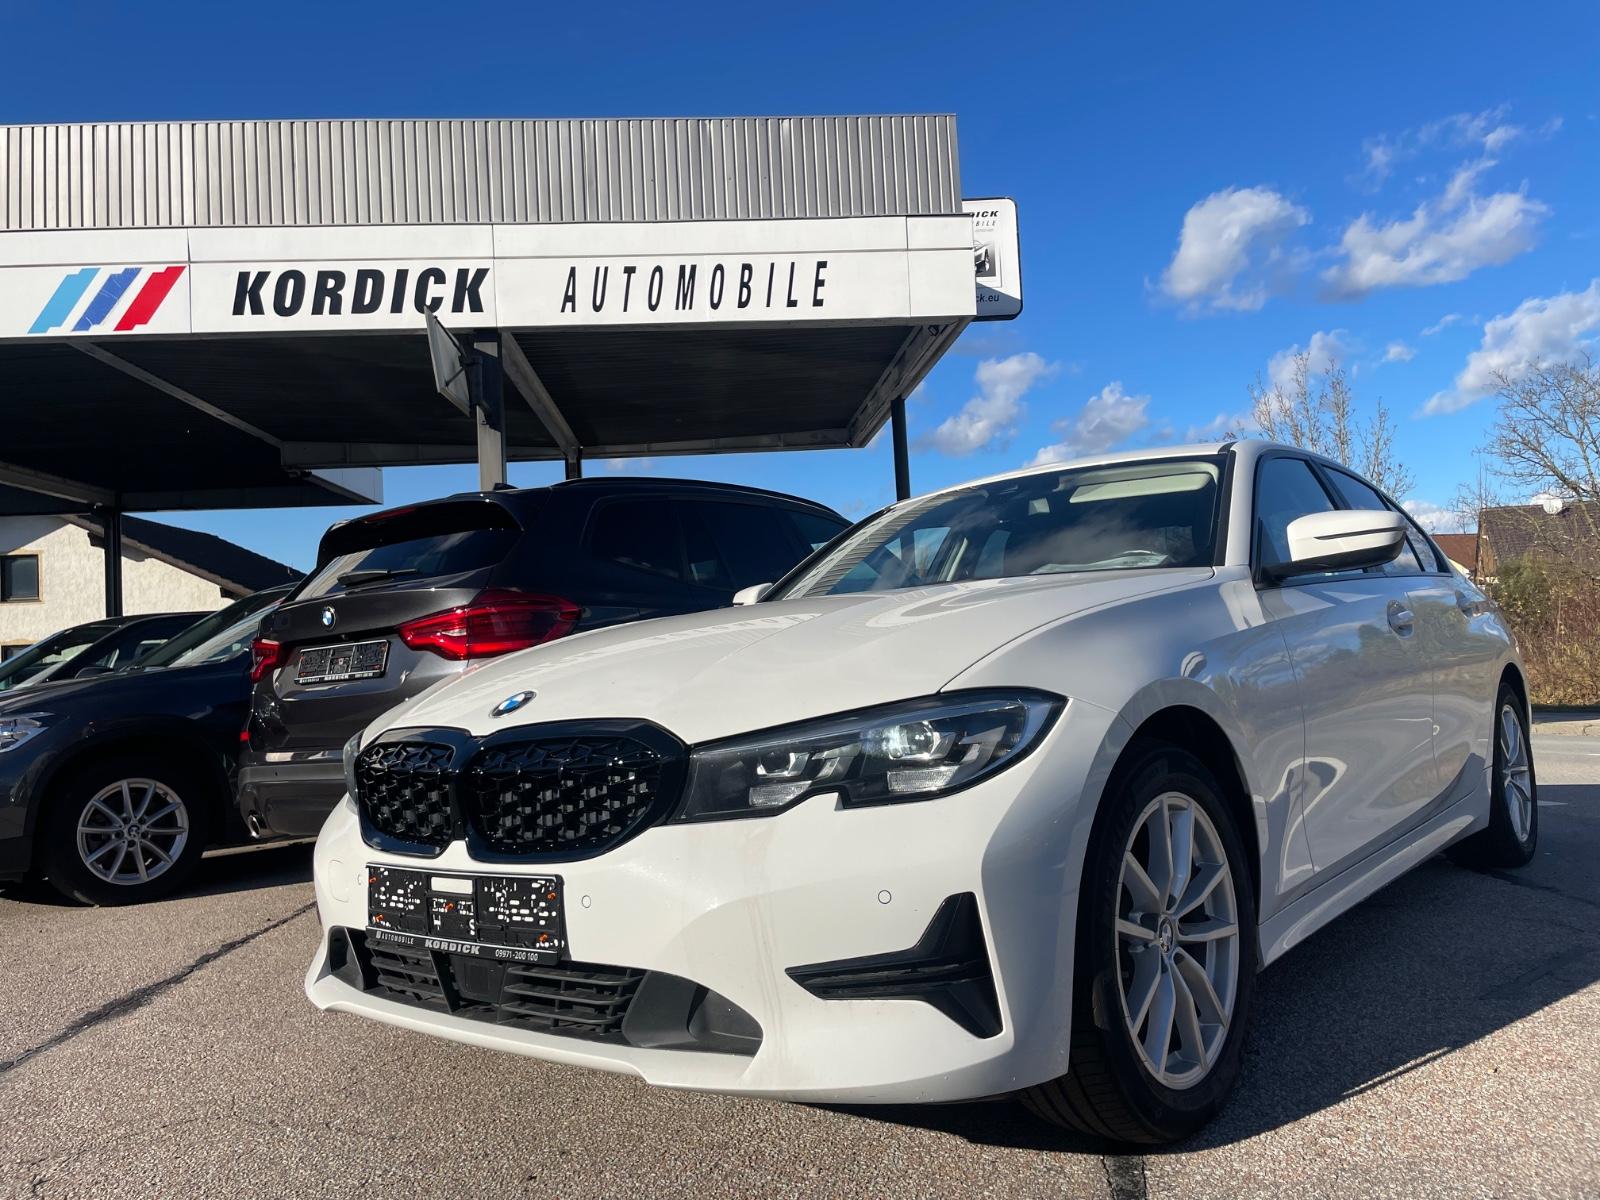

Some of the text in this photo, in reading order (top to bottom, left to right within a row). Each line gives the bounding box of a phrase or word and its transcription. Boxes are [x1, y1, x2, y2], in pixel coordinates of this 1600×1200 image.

[231, 260, 828, 317] KORDICK AUTOMOBILE
[381, 933, 415, 945] AUTOMOBILE
[424, 939, 480, 955] KORDICK
